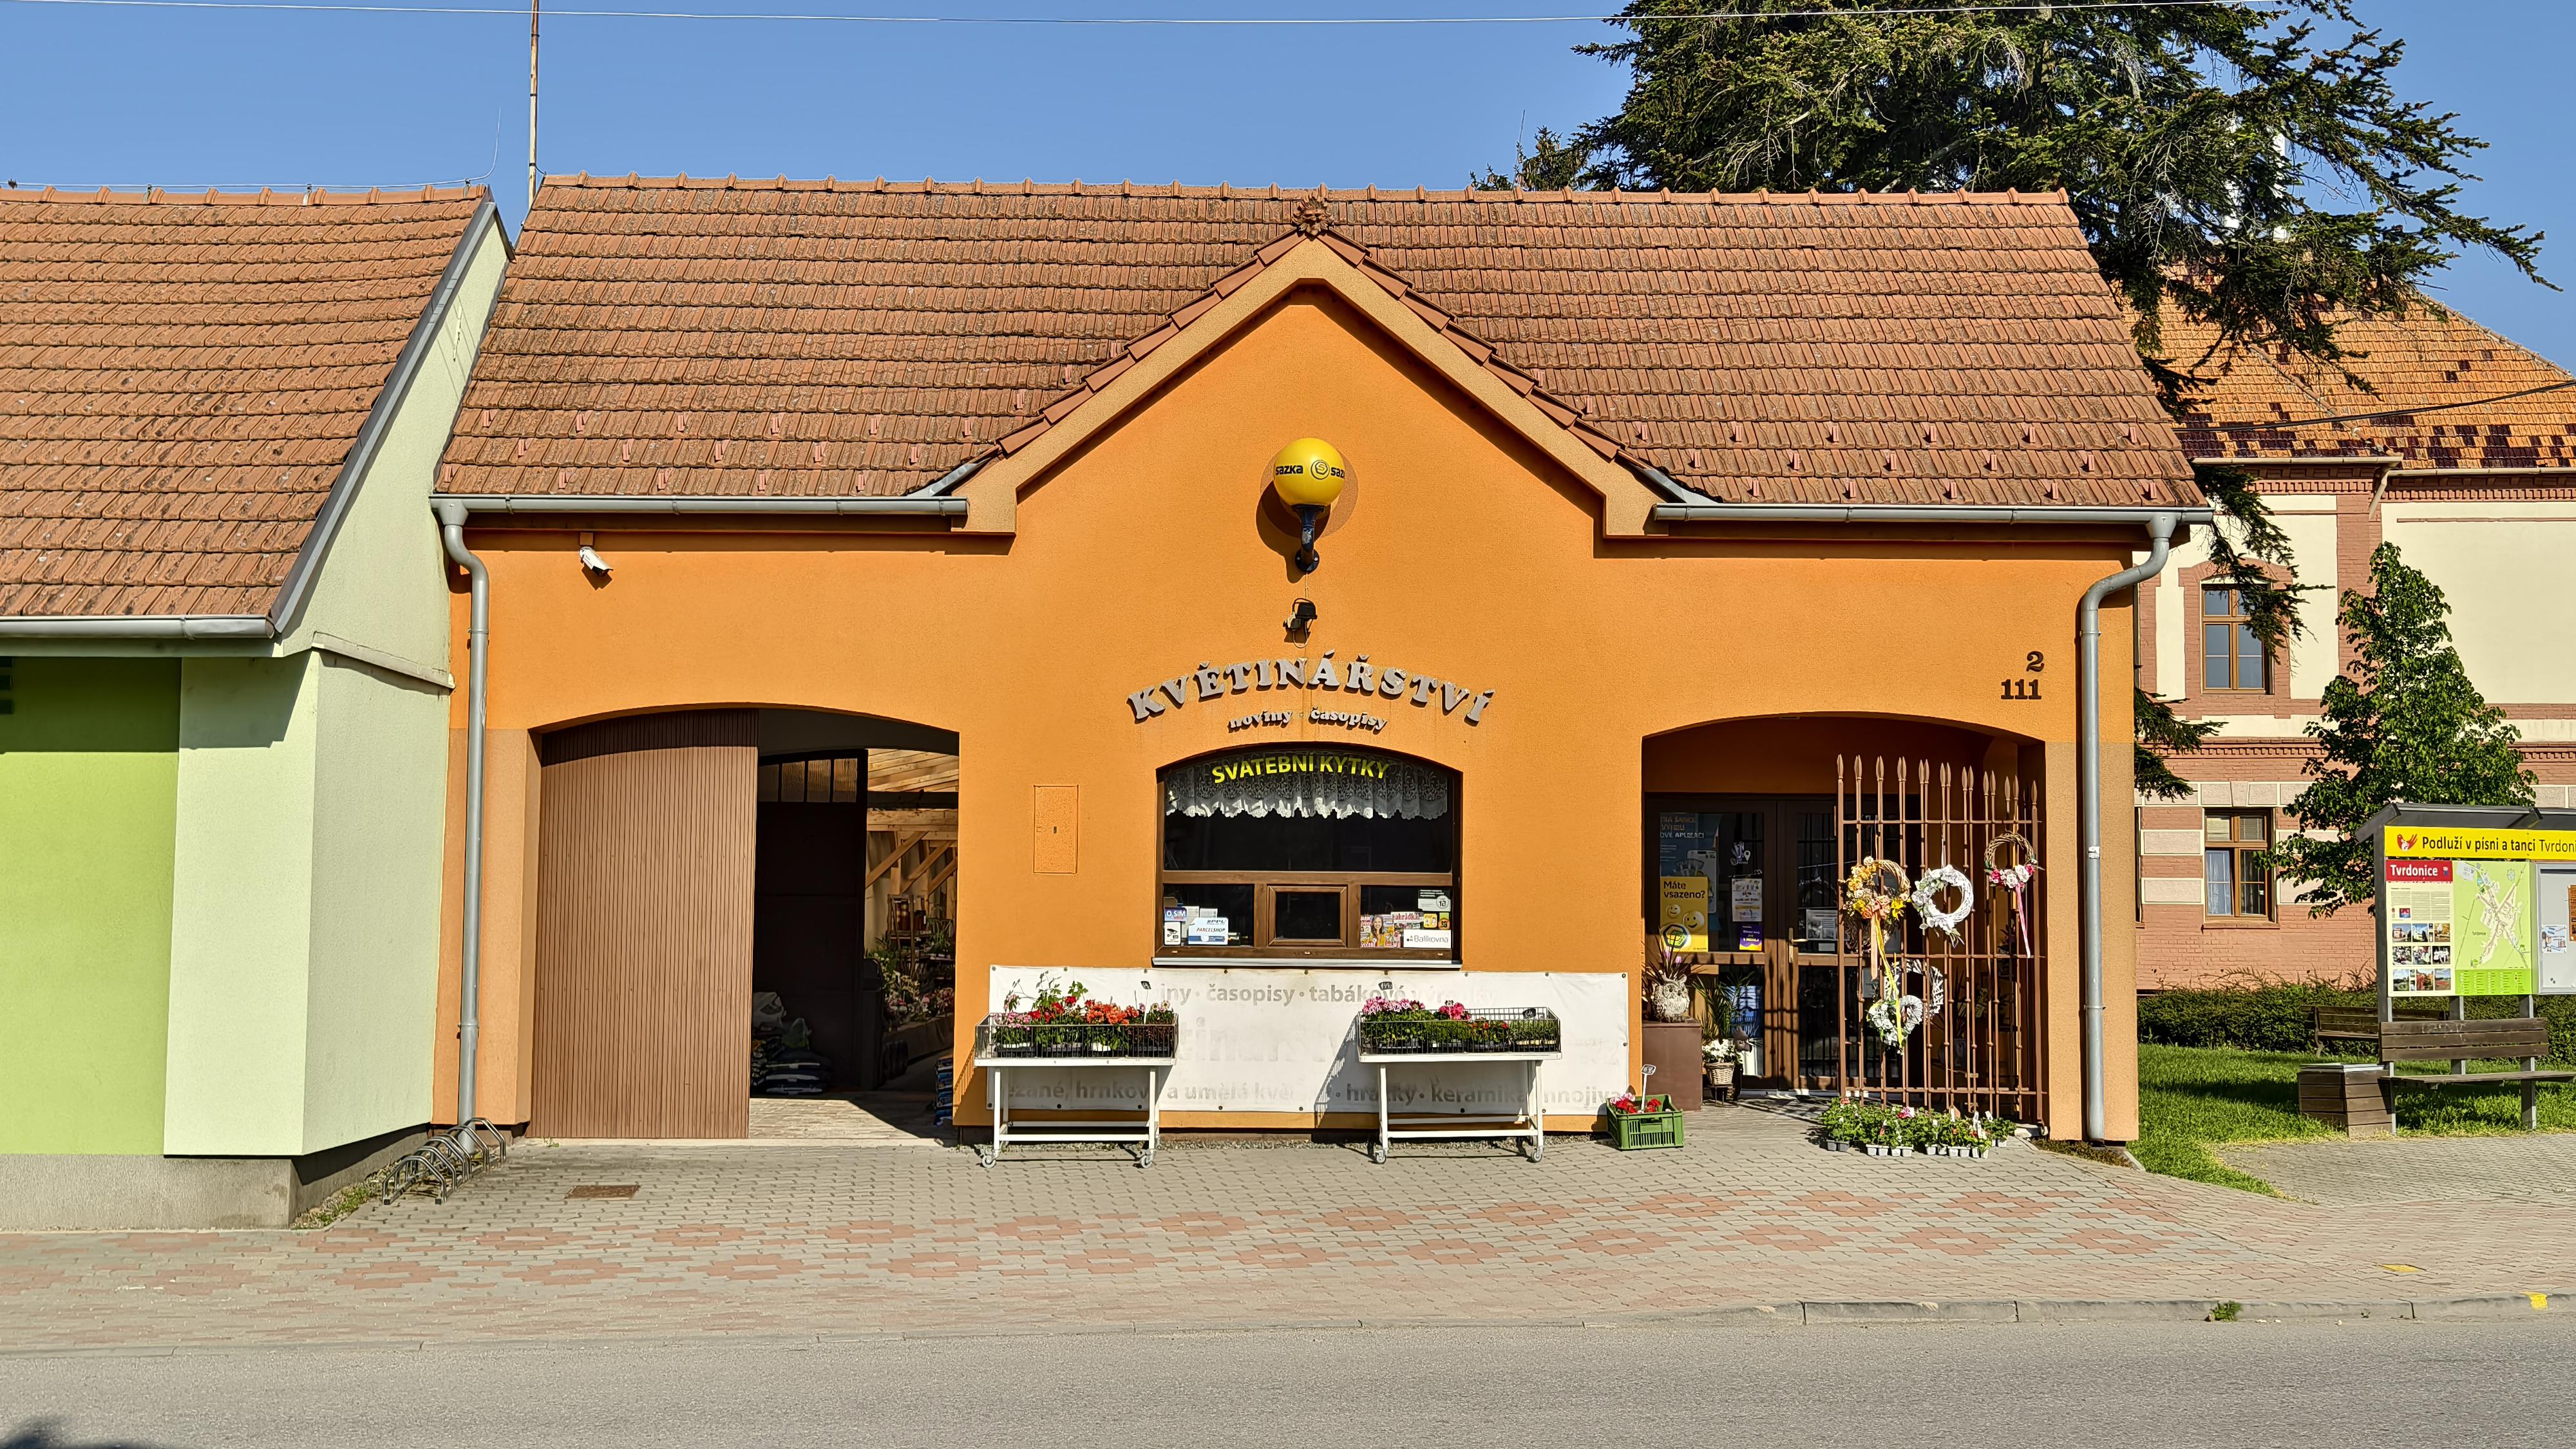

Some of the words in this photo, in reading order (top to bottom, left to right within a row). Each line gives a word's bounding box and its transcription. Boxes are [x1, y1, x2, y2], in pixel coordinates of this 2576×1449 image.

[2026, 650, 2045, 672] 2
[1129, 649, 1495, 723] KVĚTINÁŘSTVÍ
[2001, 679, 2042, 700] 111
[1229, 709, 1293, 729] noviny
[1310, 705, 1388, 731] časopisy
[1213, 752, 1314, 784] SVATEBNÍ
[1320, 755, 1390, 779] KYTKY
[2422, 836, 2463, 850] Podluží
[2466, 840, 2472, 849] v
[2475, 838, 2499, 853] písni
[2502, 841, 2507, 851] a
[2511, 838, 2535, 851] tanci
[2390, 864, 2438, 876] Tvrdonice
[1663, 881, 1686, 889] Máte
[1663, 891, 1705, 899] vsazeno?
[1414, 934, 1449, 943] Balíkovna
[1206, 983, 1296, 1007] časopisy
[1076, 1081, 1151, 1099] hrnkov
[1167, 1086, 1178, 1099] a
